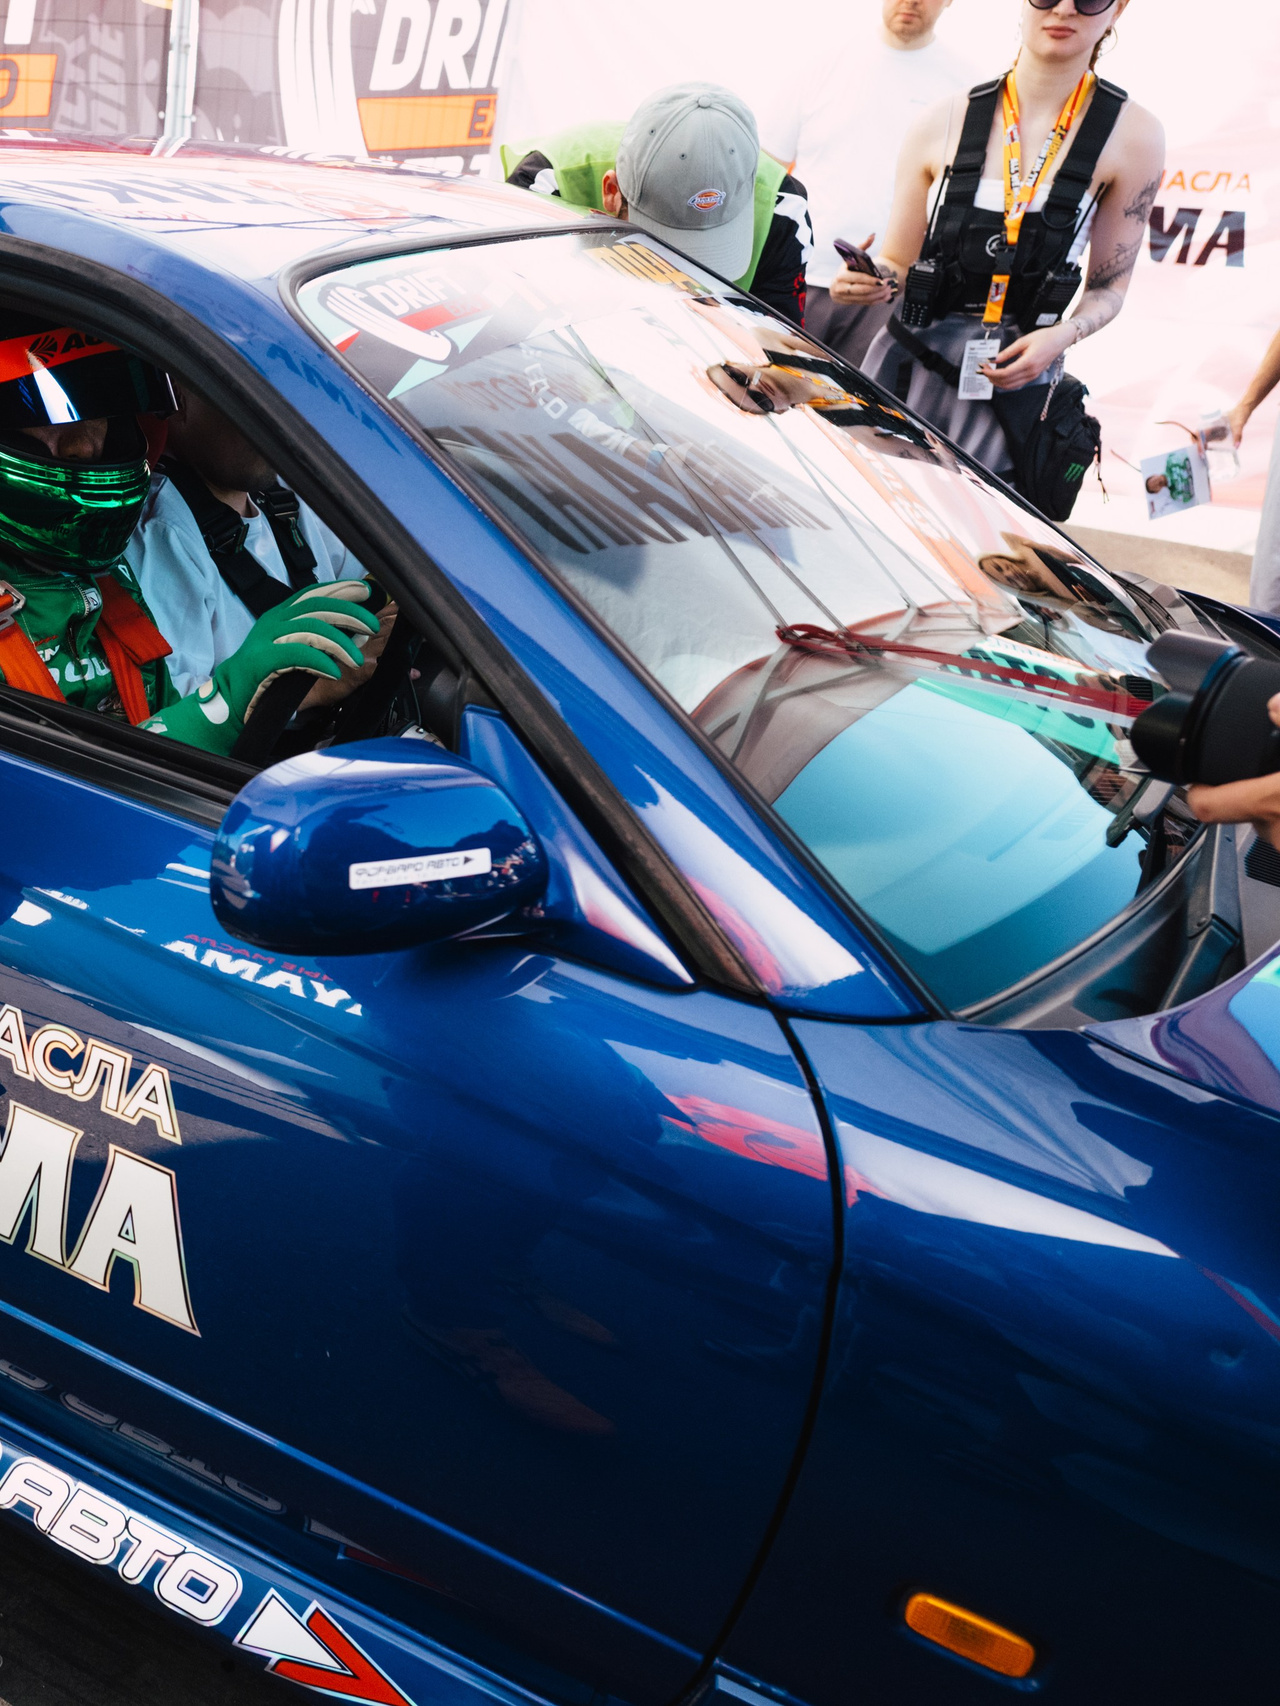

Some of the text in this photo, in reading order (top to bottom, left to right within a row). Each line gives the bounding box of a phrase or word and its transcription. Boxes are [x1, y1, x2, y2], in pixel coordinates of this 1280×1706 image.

[369, 0, 508, 91] DRI
[468, 99, 496, 139] E
[1159, 169, 1251, 193] АСЛА
[1148, 206, 1246, 268] MA
[366, 267, 467, 316] DRIFT
